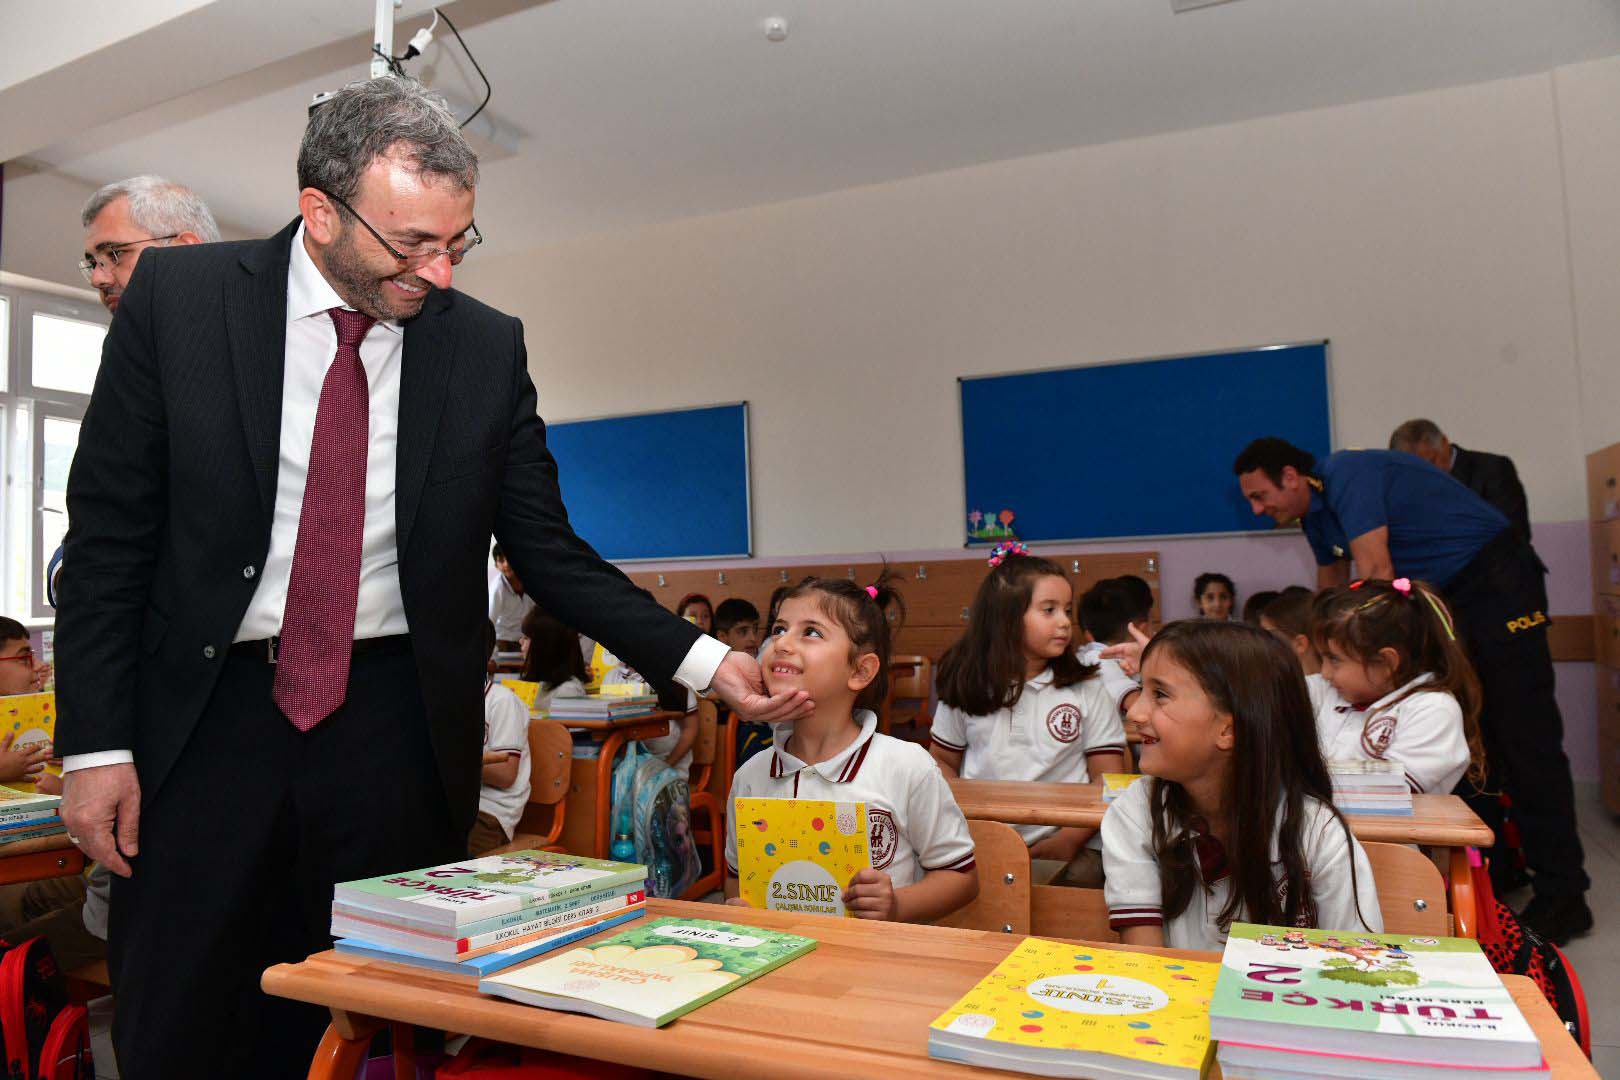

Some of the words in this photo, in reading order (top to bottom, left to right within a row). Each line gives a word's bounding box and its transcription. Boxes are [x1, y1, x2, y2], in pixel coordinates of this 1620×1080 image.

[424, 867, 478, 878] 2
[382, 877, 496, 901] TÜRKÇE
[772, 881, 838, 902] 2.SINIF
[522, 921, 542, 933] HAYAT
[671, 929, 718, 939] SINIF
[1246, 963, 1302, 984] 2
[1032, 988, 1154, 1010] 2.SINIF
[1241, 988, 1503, 1021] TÜRKÇE
